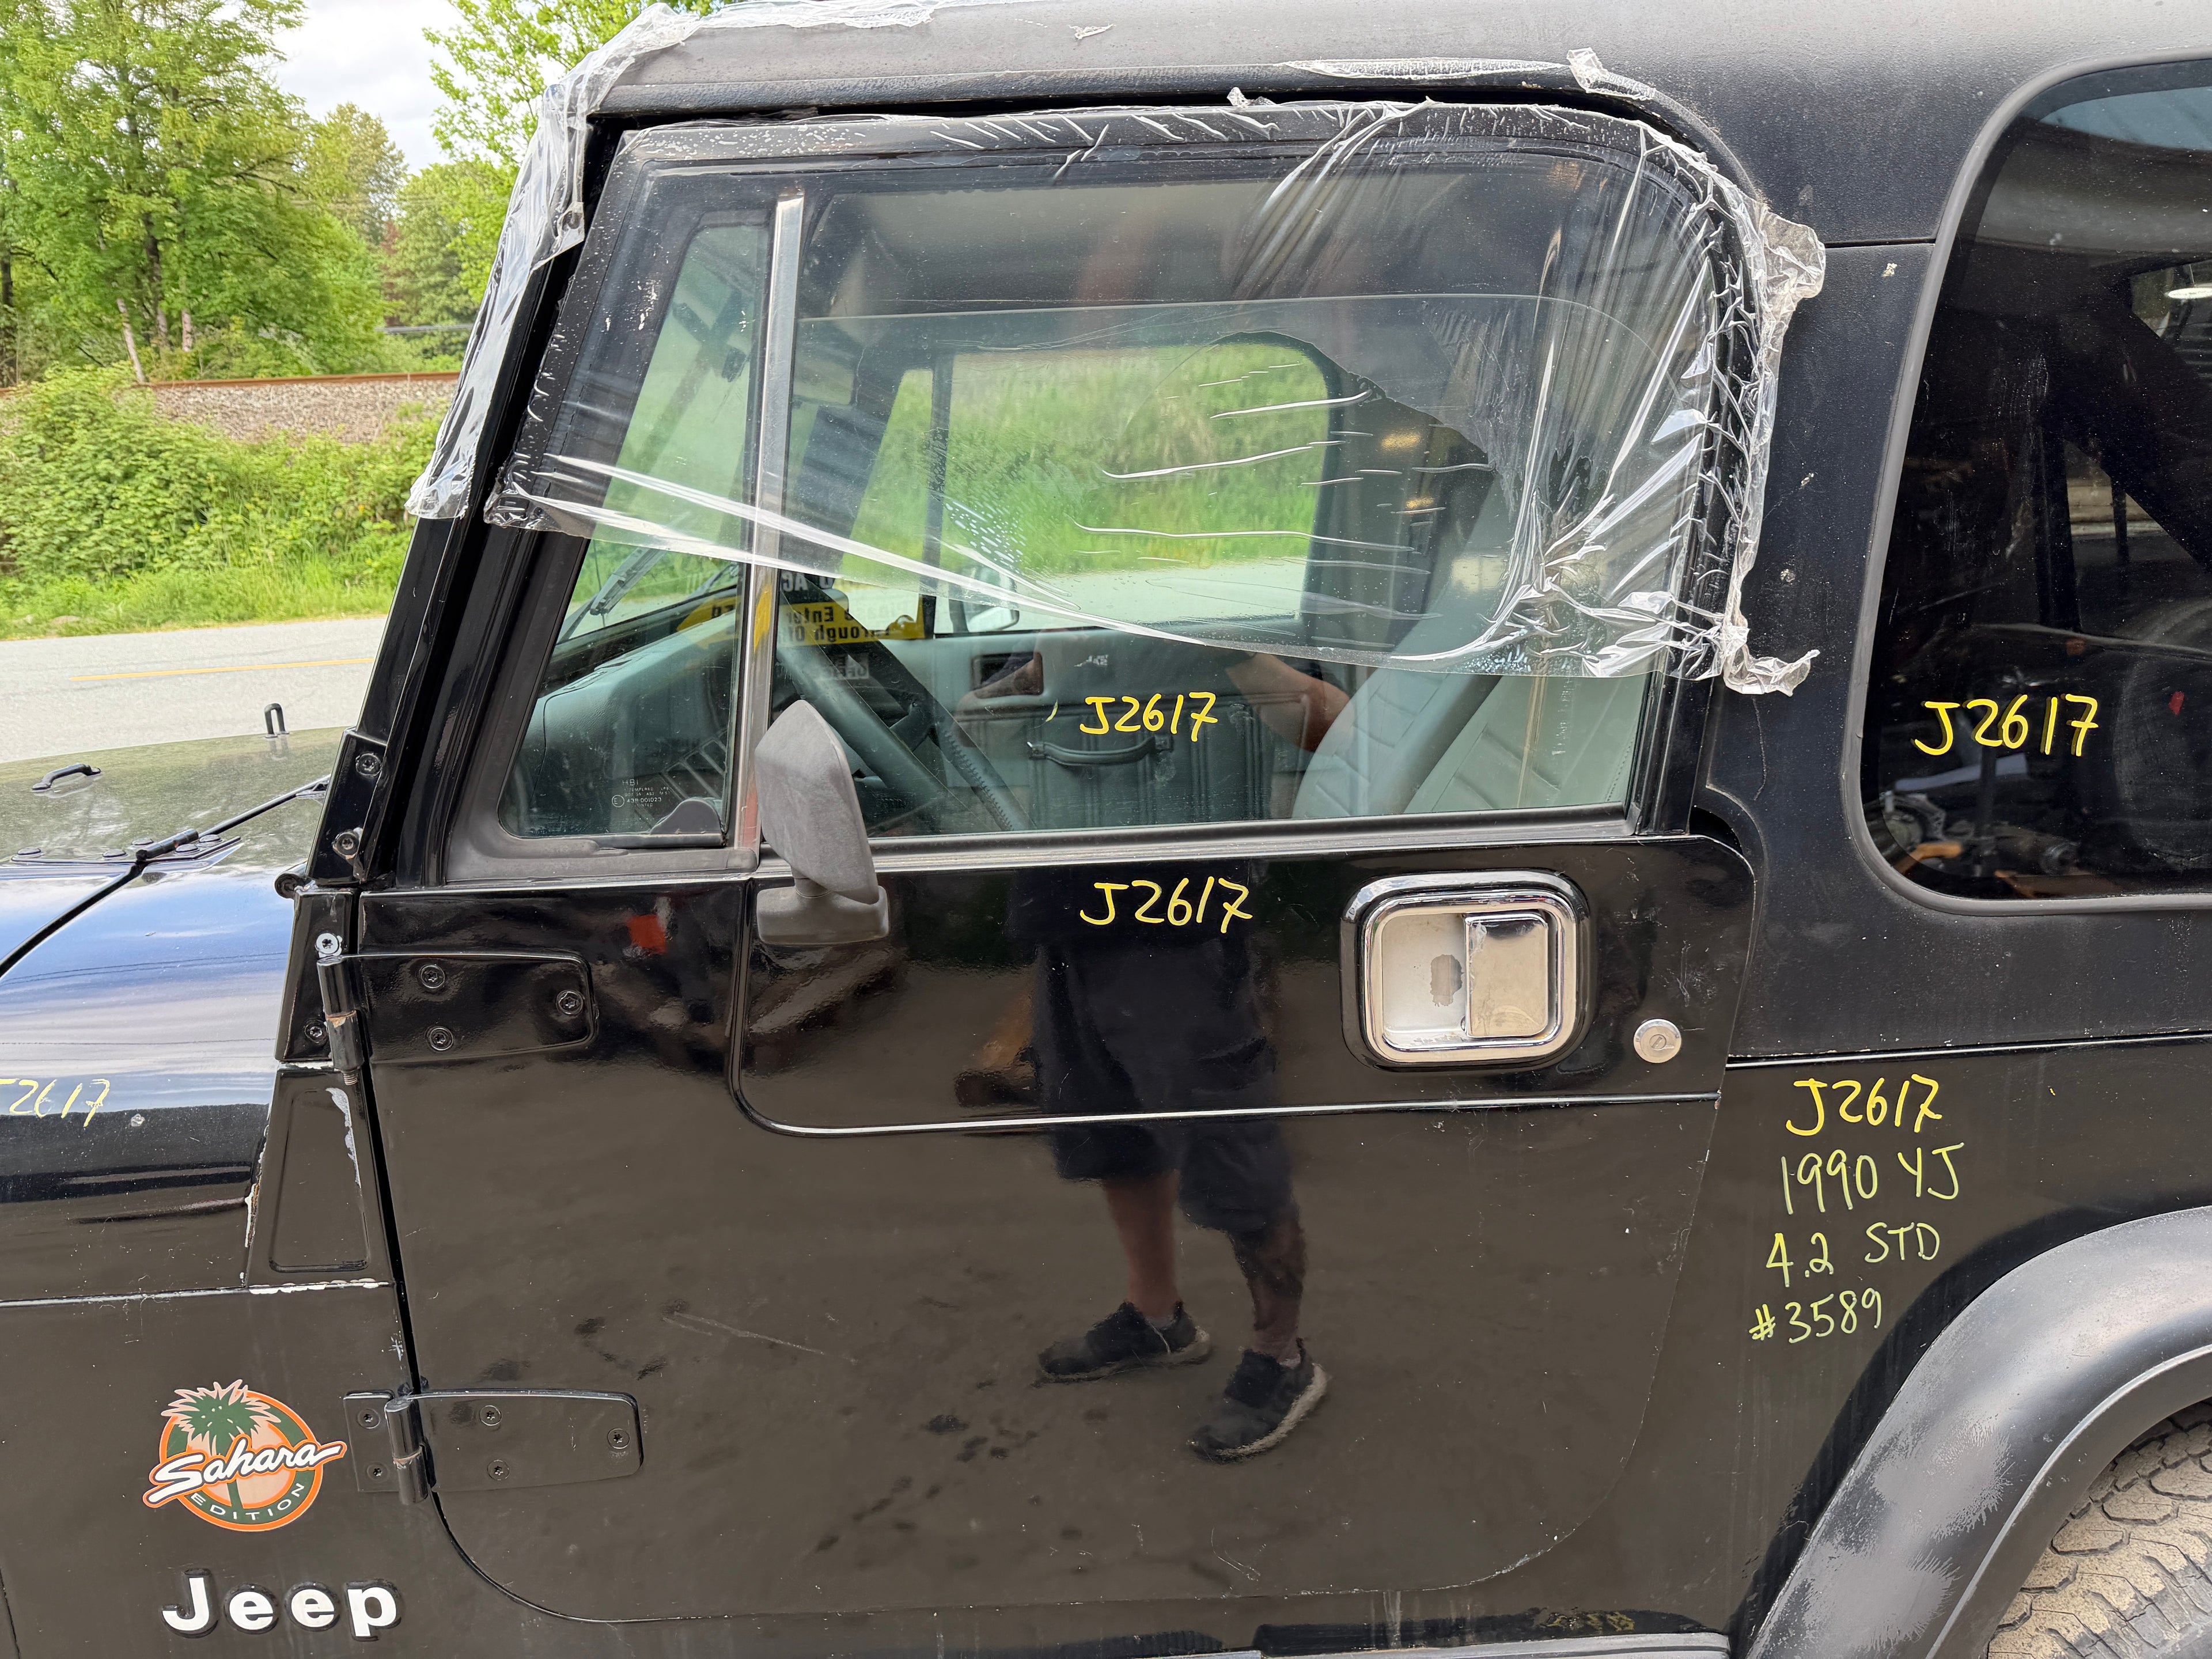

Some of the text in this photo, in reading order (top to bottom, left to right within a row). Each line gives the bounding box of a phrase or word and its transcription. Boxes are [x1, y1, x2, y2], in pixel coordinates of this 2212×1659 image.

[1080, 692, 1218, 742] J2617
[1914, 694, 2099, 757] J2617
[1080, 876, 1253, 933] J2617
[0, 1078, 111, 1127] 2617
[1786, 1074, 1942, 1136] J2617
[1781, 1142, 1964, 1214] 1990 YJ
[1766, 1222, 1940, 1287] 4.2 STD
[1749, 1287, 1883, 1343] #3589
[147, 1438, 342, 1503] Sahara
[190, 1482, 305, 1521] EDITION
[161, 1574, 399, 1639] Jeep
